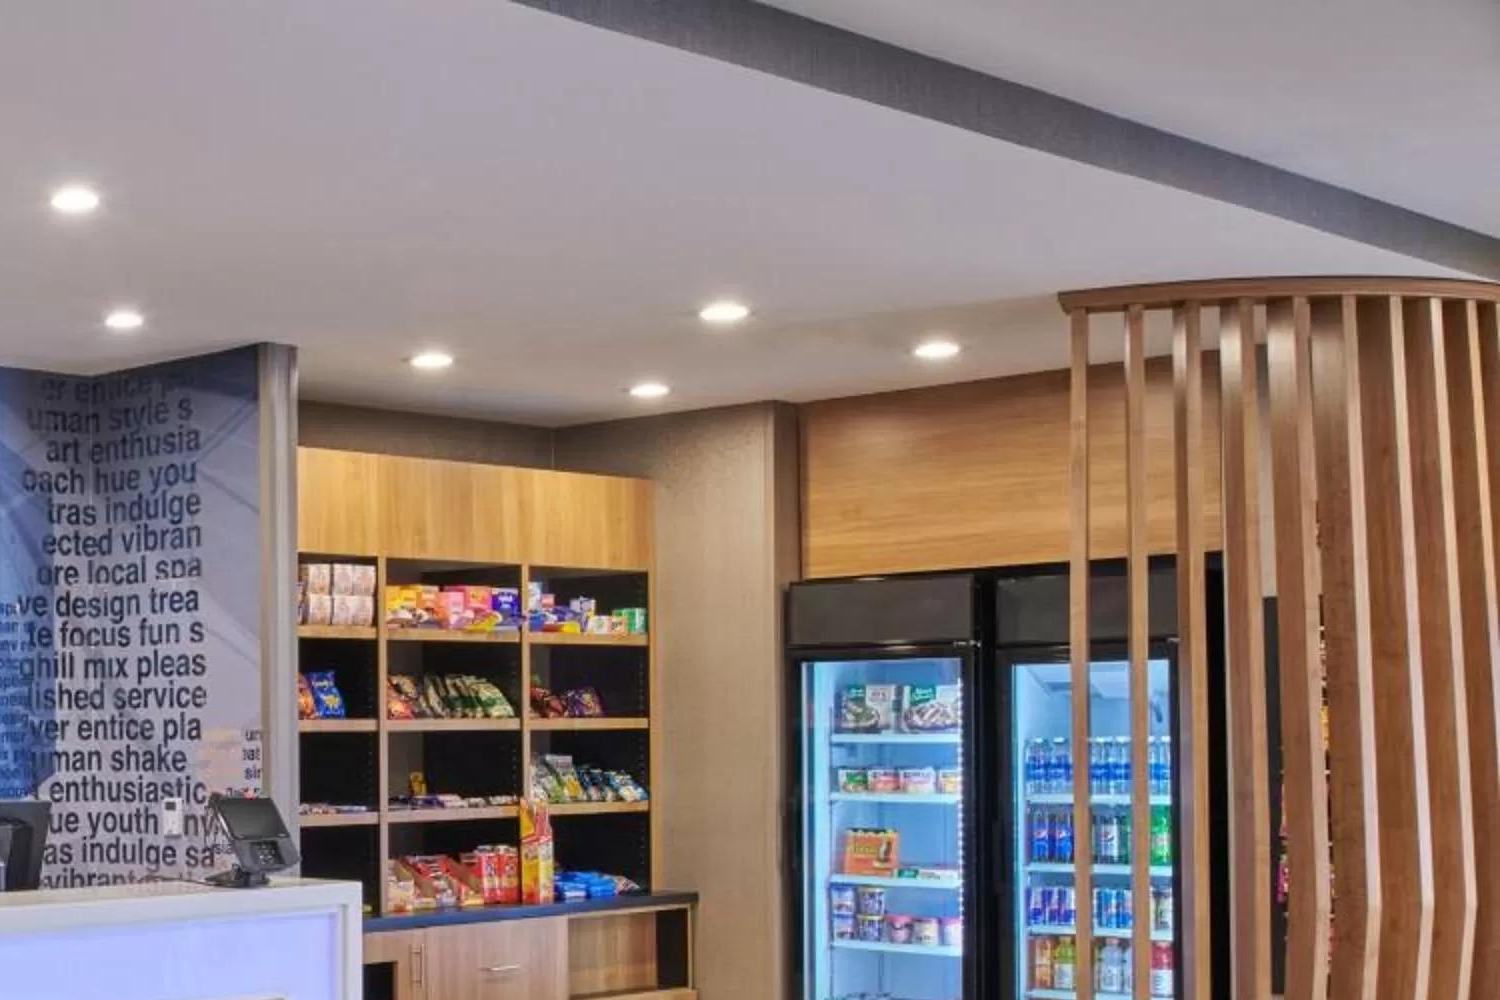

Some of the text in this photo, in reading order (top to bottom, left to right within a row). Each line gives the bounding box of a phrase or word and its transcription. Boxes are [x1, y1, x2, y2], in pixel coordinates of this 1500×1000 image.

[107, 396, 170, 435] style
[46, 425, 200, 465] art enthusia
[95, 466, 141, 494] hue
[150, 461, 197, 495] you
[47, 491, 201, 526] tras indulge
[41, 523, 201, 557] ected vibran
[37, 564, 79, 586] ore
[87, 556, 147, 586] local
[55, 589, 141, 624] design
[149, 587, 200, 613] trea
[60, 620, 132, 648] focus
[139, 618, 181, 646] fun
[189, 621, 205, 644] s
[83, 656, 129, 679] mix
[137, 649, 207, 684] pleas
[113, 680, 208, 709] service
[29, 718, 70, 743] ver
[77, 713, 156, 741] entice
[162, 711, 202, 747] pla
[110, 745, 187, 773] shake
[49, 775, 208, 804] enthusiastic
[88, 806, 160, 839] youth
[43, 844, 73, 865] as
[81, 836, 178, 873] indulge
[184, 844, 215, 868] sa
